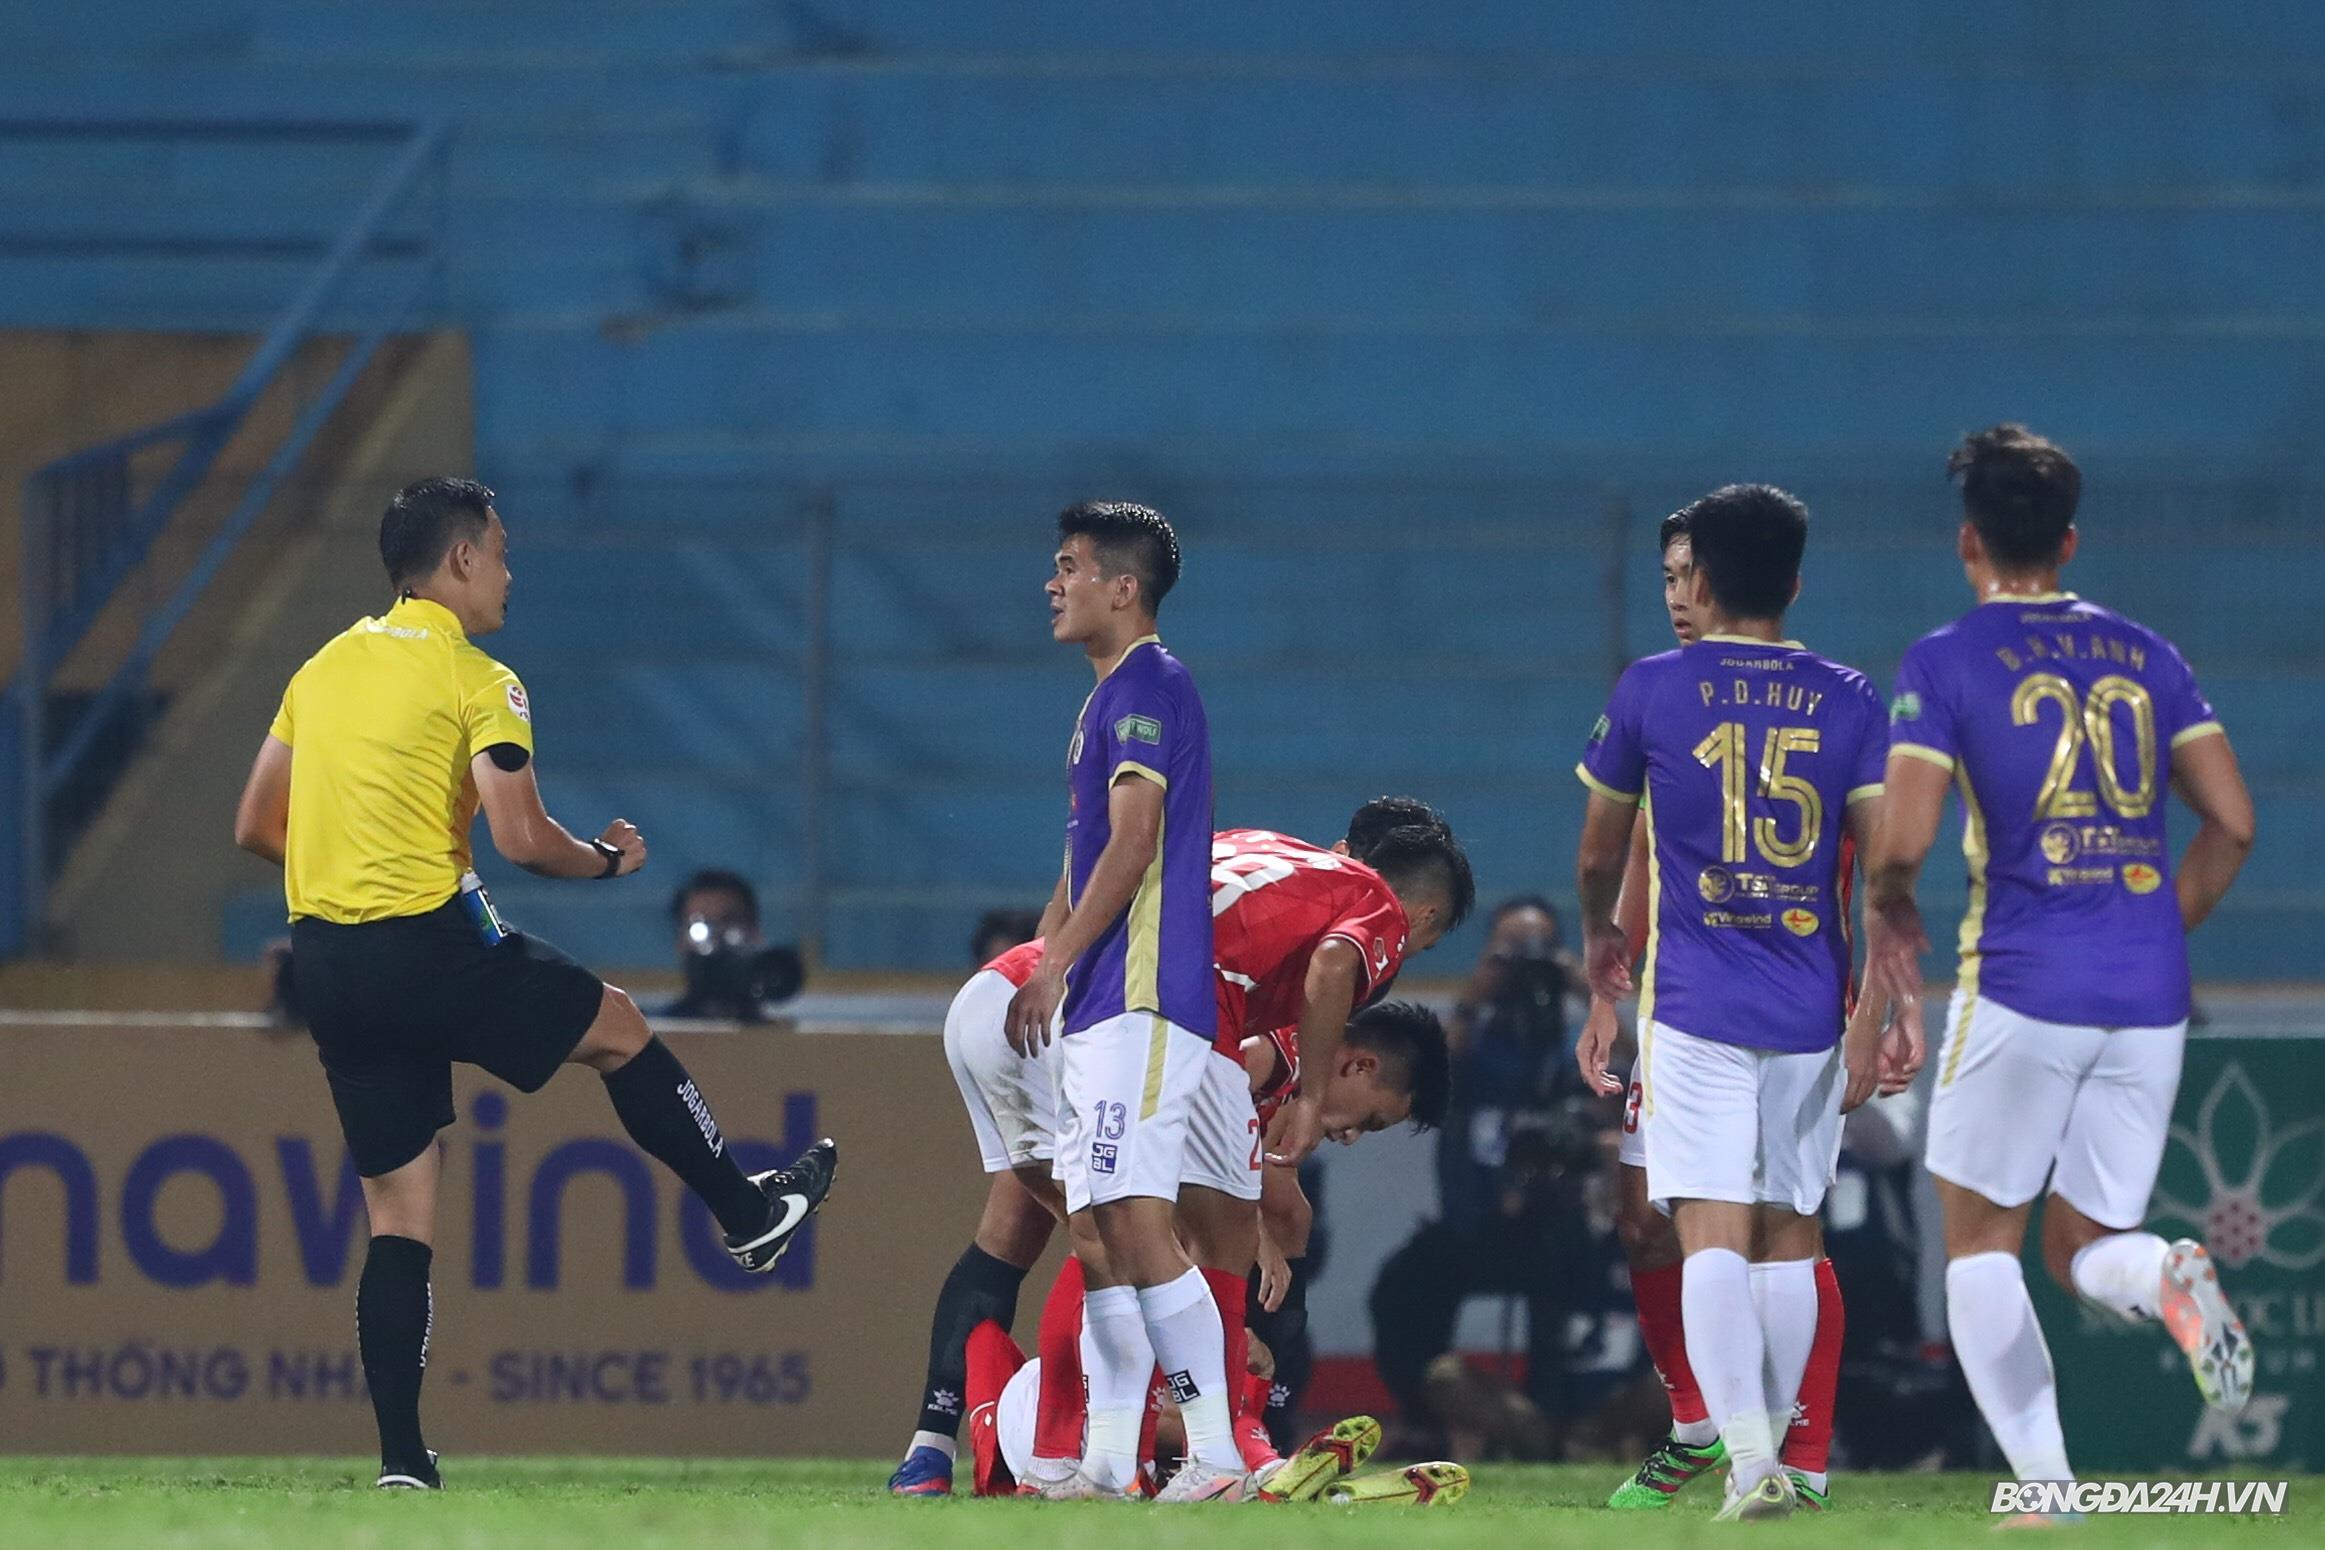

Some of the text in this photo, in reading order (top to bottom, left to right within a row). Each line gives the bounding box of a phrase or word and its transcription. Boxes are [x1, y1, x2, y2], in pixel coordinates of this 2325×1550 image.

[1700, 680, 1822, 716] P.D.HUY
[2011, 672, 2156, 821] 20
[1692, 722, 1822, 868] 15
[677, 1079, 724, 1159] JOGARBOLA
[1094, 1099, 1127, 1140] 13
[1624, 1082, 1642, 1133] 3
[1248, 1118, 1262, 1171] 2
[491, 1350, 671, 1401] SINCE
[690, 1350, 813, 1401] 1965
